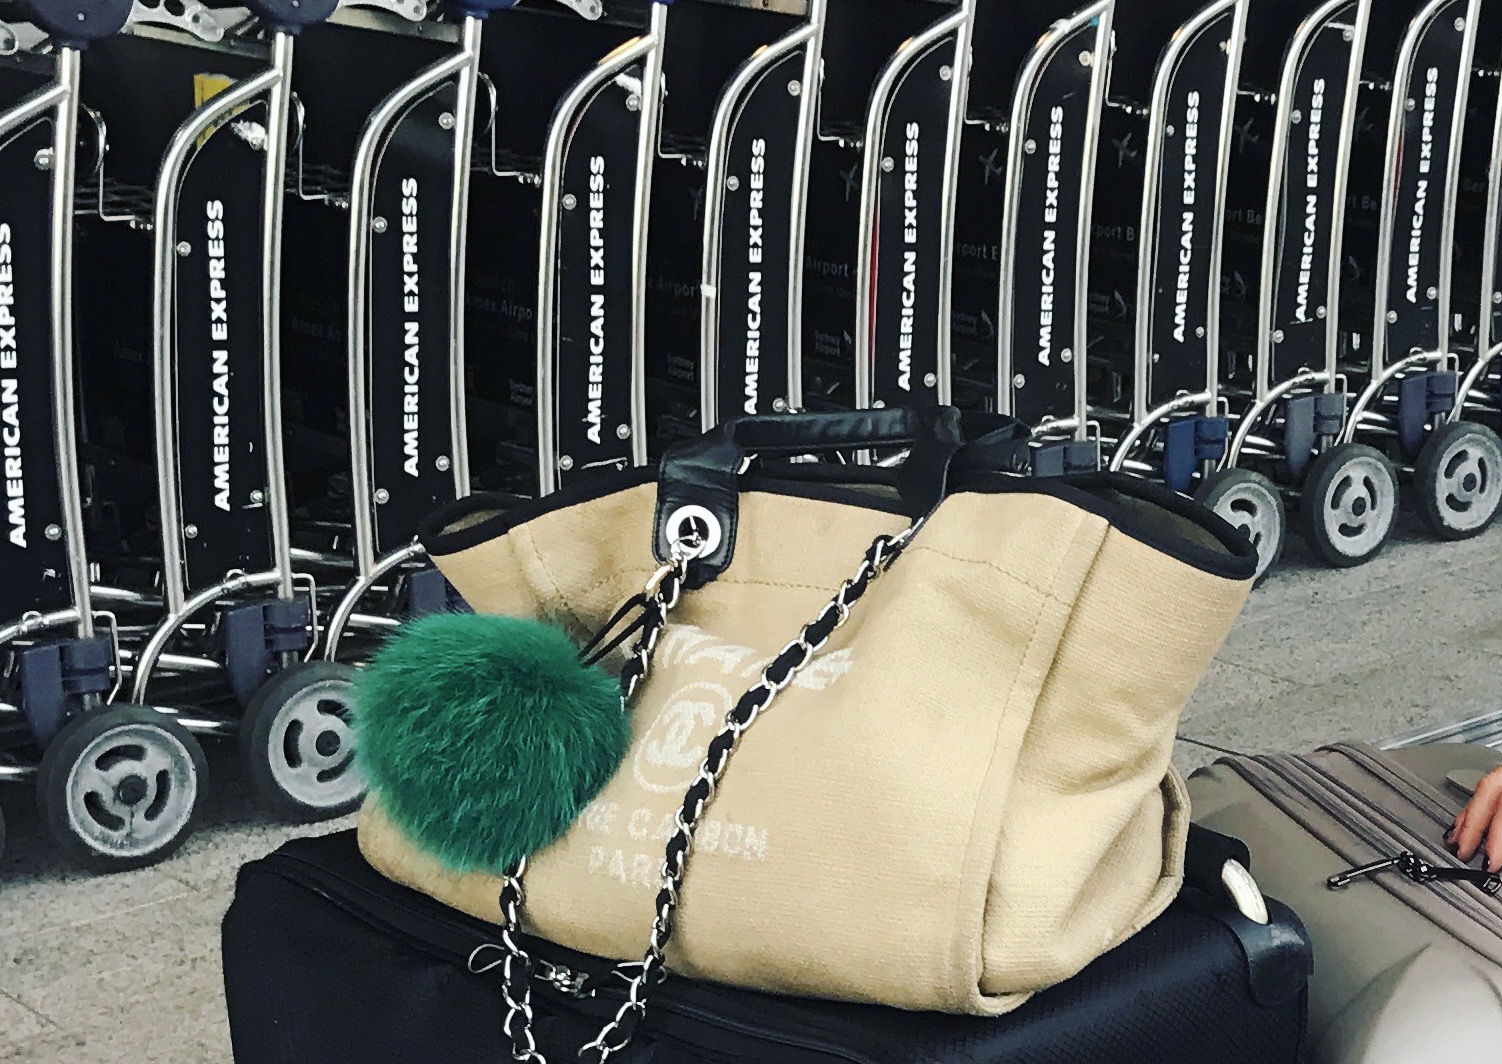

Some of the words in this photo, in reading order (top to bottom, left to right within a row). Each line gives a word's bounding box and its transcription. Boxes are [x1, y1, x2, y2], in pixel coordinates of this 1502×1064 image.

[590, 156, 604, 285] EXPRESS
[749, 139, 765, 263] EXPRESS
[905, 122, 919, 243] EXPRESS
[1045, 107, 1063, 222] EXPRESS
[1174, 212, 1193, 342] AMERICAN
[1184, 91, 1199, 204] EXPRESS
[1296, 195, 1317, 323] AMERICAN
[1307, 79, 1325, 187] EXPRESS
[1406, 180, 1428, 303] AMERICAN
[1420, 68, 1438, 173] EXPRESS
[207, 200, 227, 340] EXPRESS
[402, 178, 418, 312] EXPRESS
[499, 300, 534, 323] Airpo
[1038, 230, 1055, 366] AMERICAN
[587, 295, 604, 444] AMERICAN
[744, 272, 761, 414] AMERICAN
[898, 252, 916, 391] AMERICAN
[0, 379, 26, 548] AMERICAN
[213, 350, 230, 511] AMERICAN
[404, 322, 419, 477] AMERICAN
[590, 846, 664, 887] PAR
